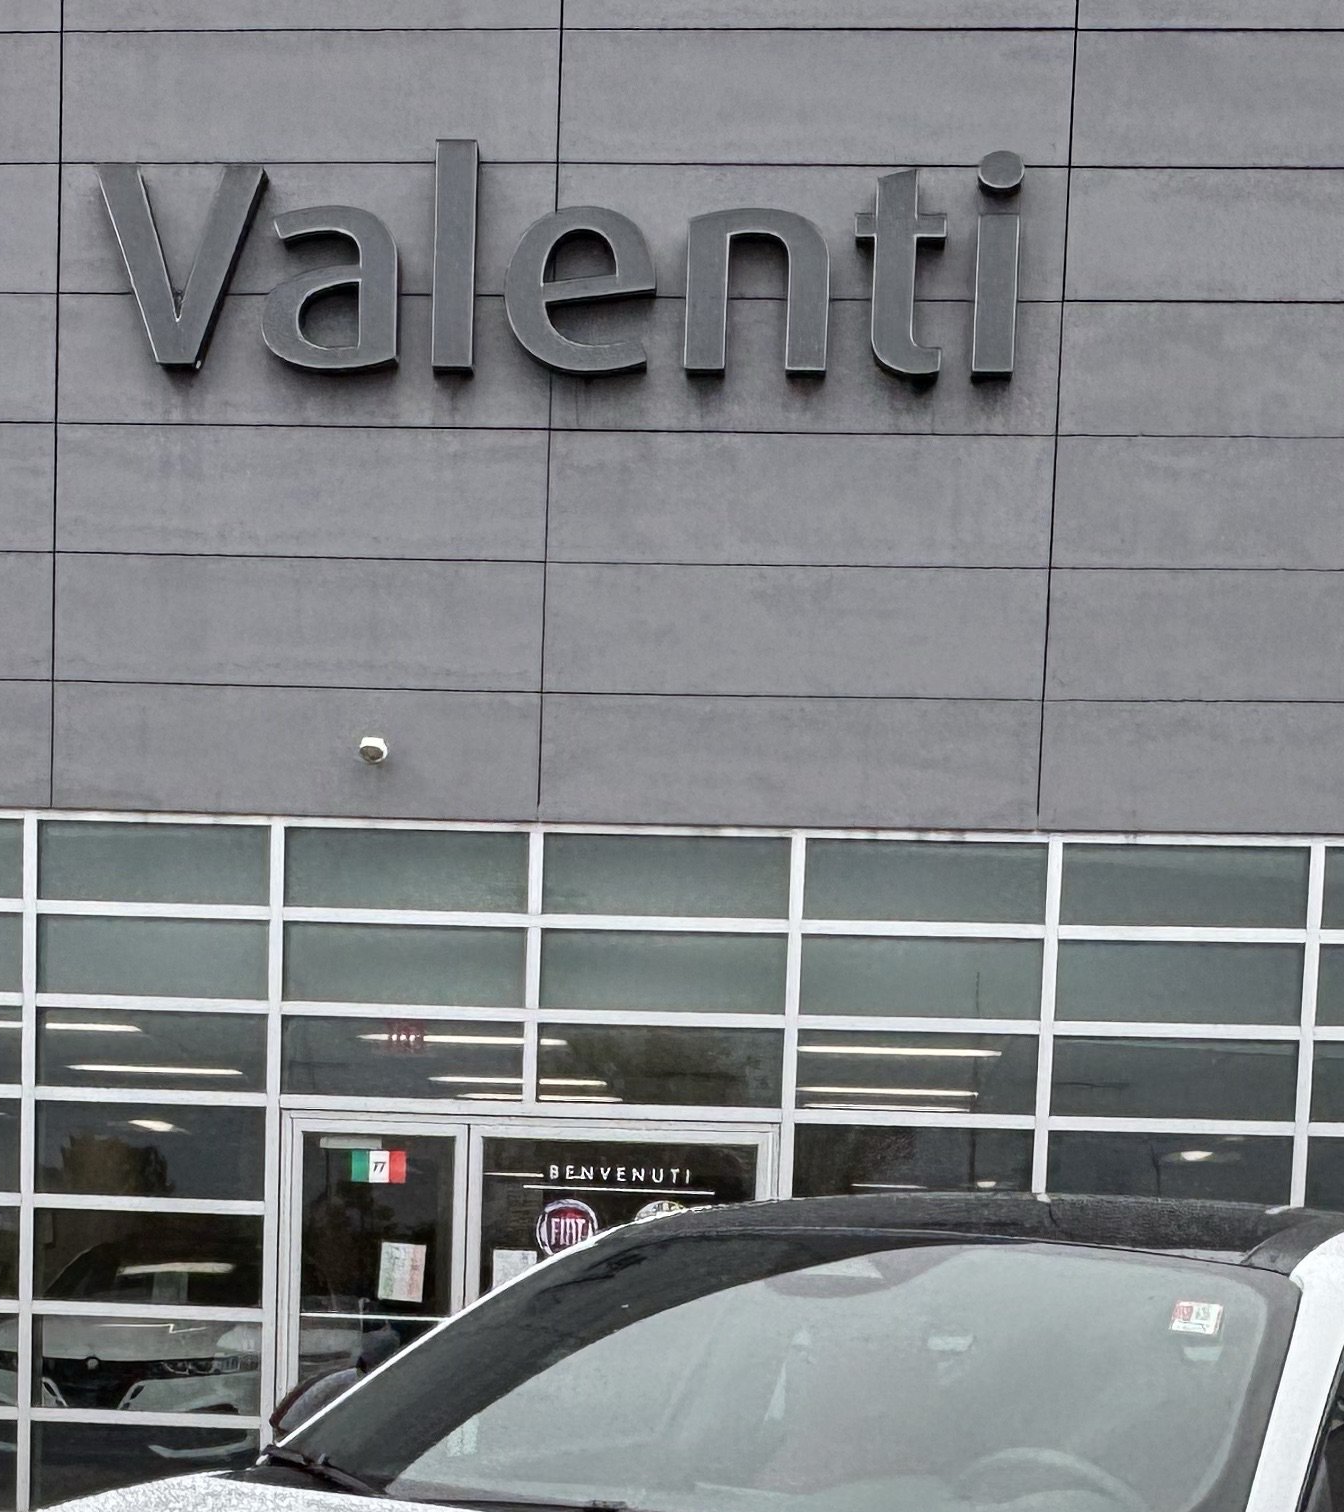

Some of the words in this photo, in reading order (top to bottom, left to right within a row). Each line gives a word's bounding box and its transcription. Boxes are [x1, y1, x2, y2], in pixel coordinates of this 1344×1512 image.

[95, 138, 1026, 379] Valenti
[549, 1164, 691, 1185] BENVENUTI
[551, 1217, 586, 1245] FIAT
